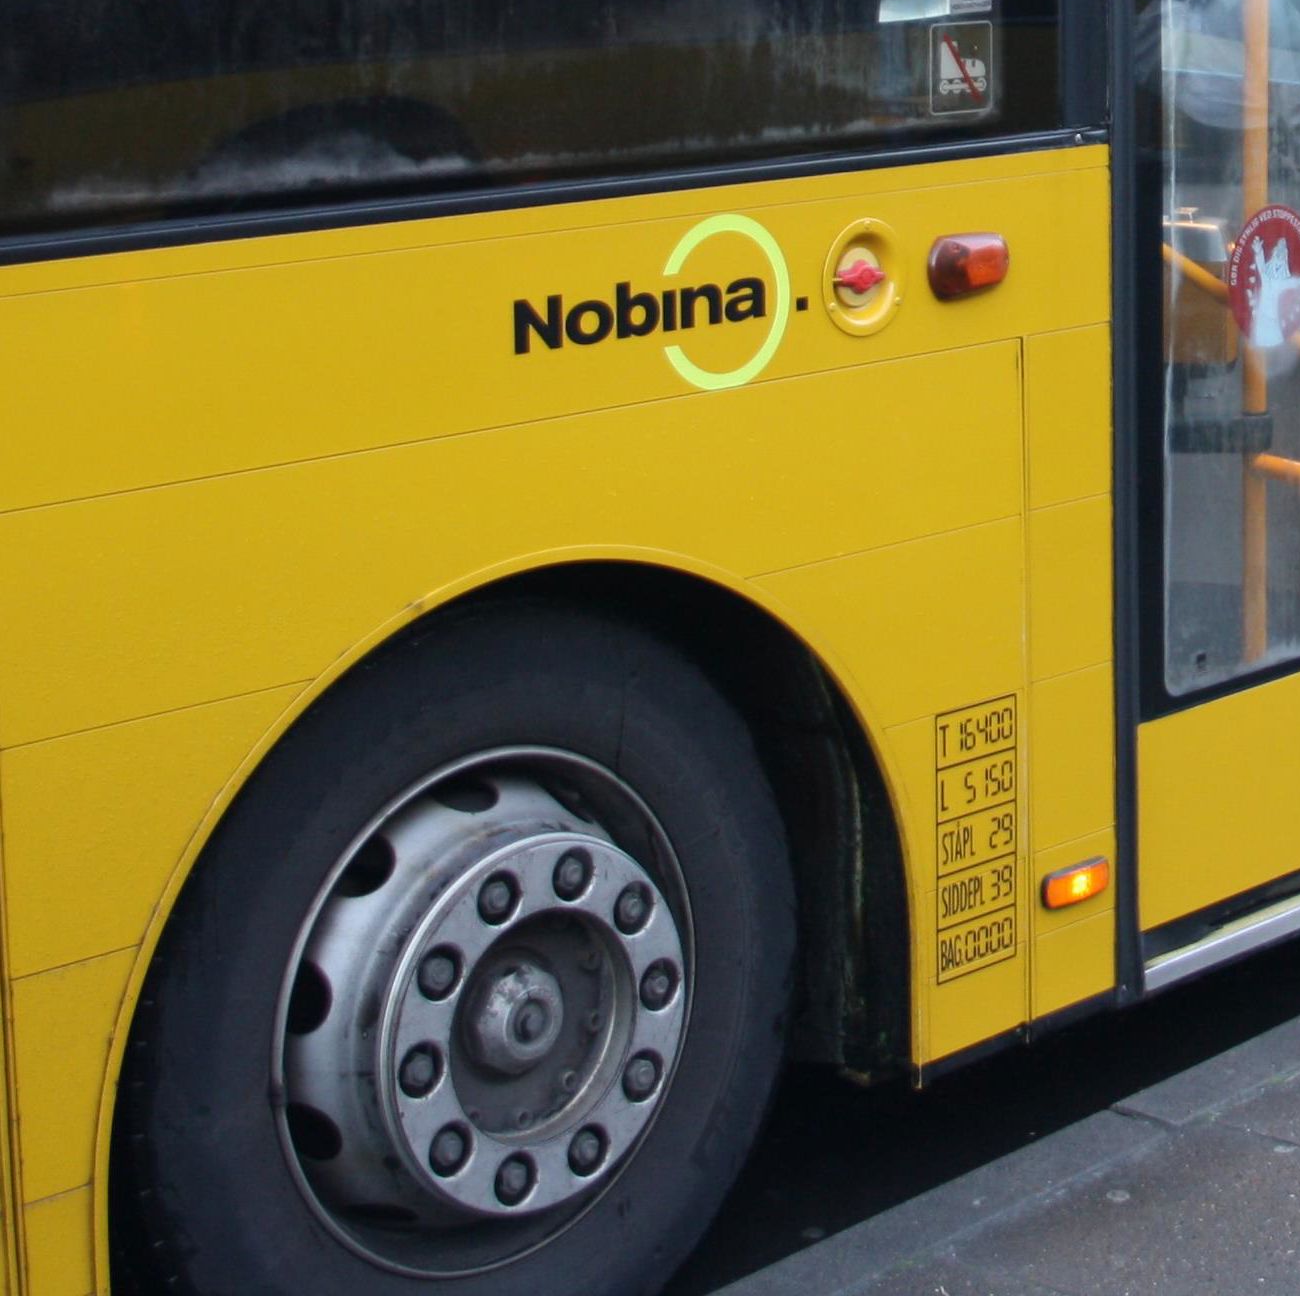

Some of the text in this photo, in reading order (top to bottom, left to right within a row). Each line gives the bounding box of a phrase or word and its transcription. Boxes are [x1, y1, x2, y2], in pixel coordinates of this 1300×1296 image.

[938, 707, 1014, 758] T 16400
[940, 779, 949, 812] L
[988, 812, 1013, 849] 29
[941, 864, 1013, 919] SIDDEPL 39
